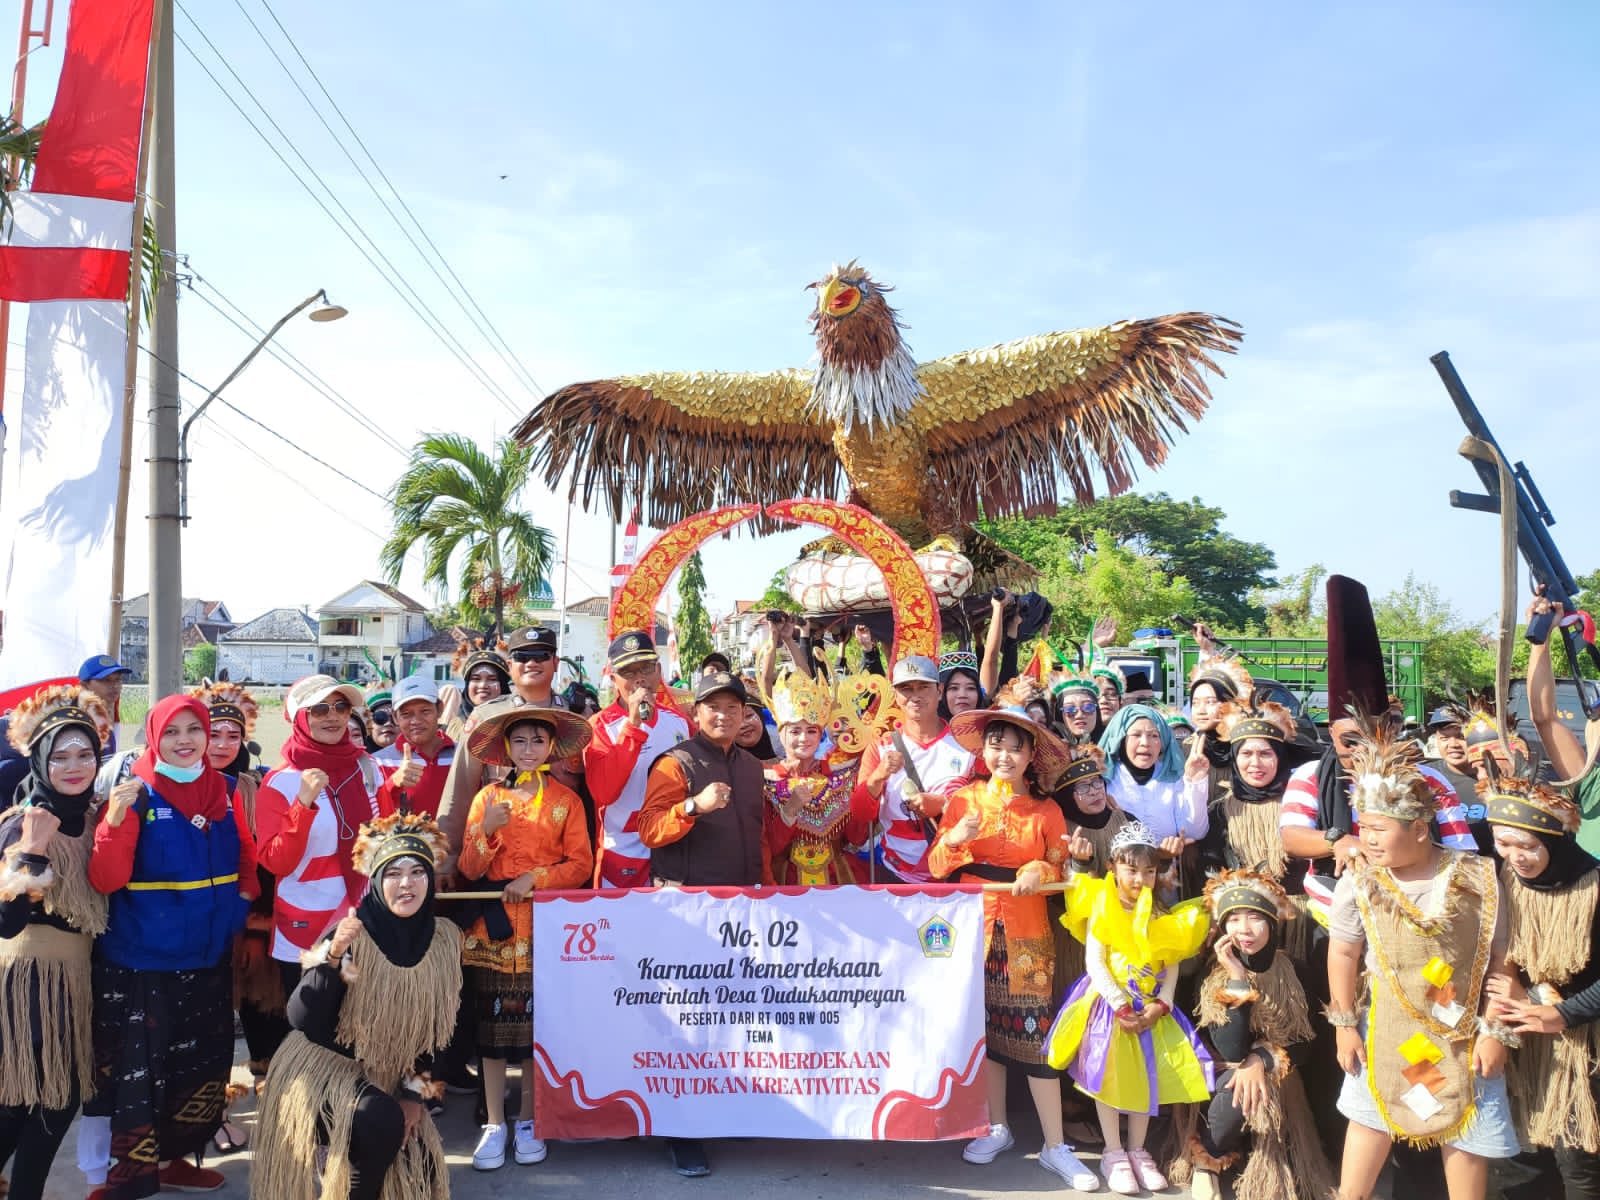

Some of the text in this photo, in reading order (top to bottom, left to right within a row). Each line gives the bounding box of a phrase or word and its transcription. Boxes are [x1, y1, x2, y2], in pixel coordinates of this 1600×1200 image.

[718, 920, 799, 948] No. 02
[637, 957, 883, 980] Karnaval Kemerdekaan
[613, 984, 906, 1008] Pemerintah Desa Duduksampeyan
[679, 1010, 840, 1026] PESERTA DARI RT 009 RW 005
[746, 1030, 774, 1044] TEMA
[632, 1051, 891, 1070] SEMANGAT KEMERDEKAAN
[645, 1075, 881, 1098] WUJUDKAN KREATIVITAS
